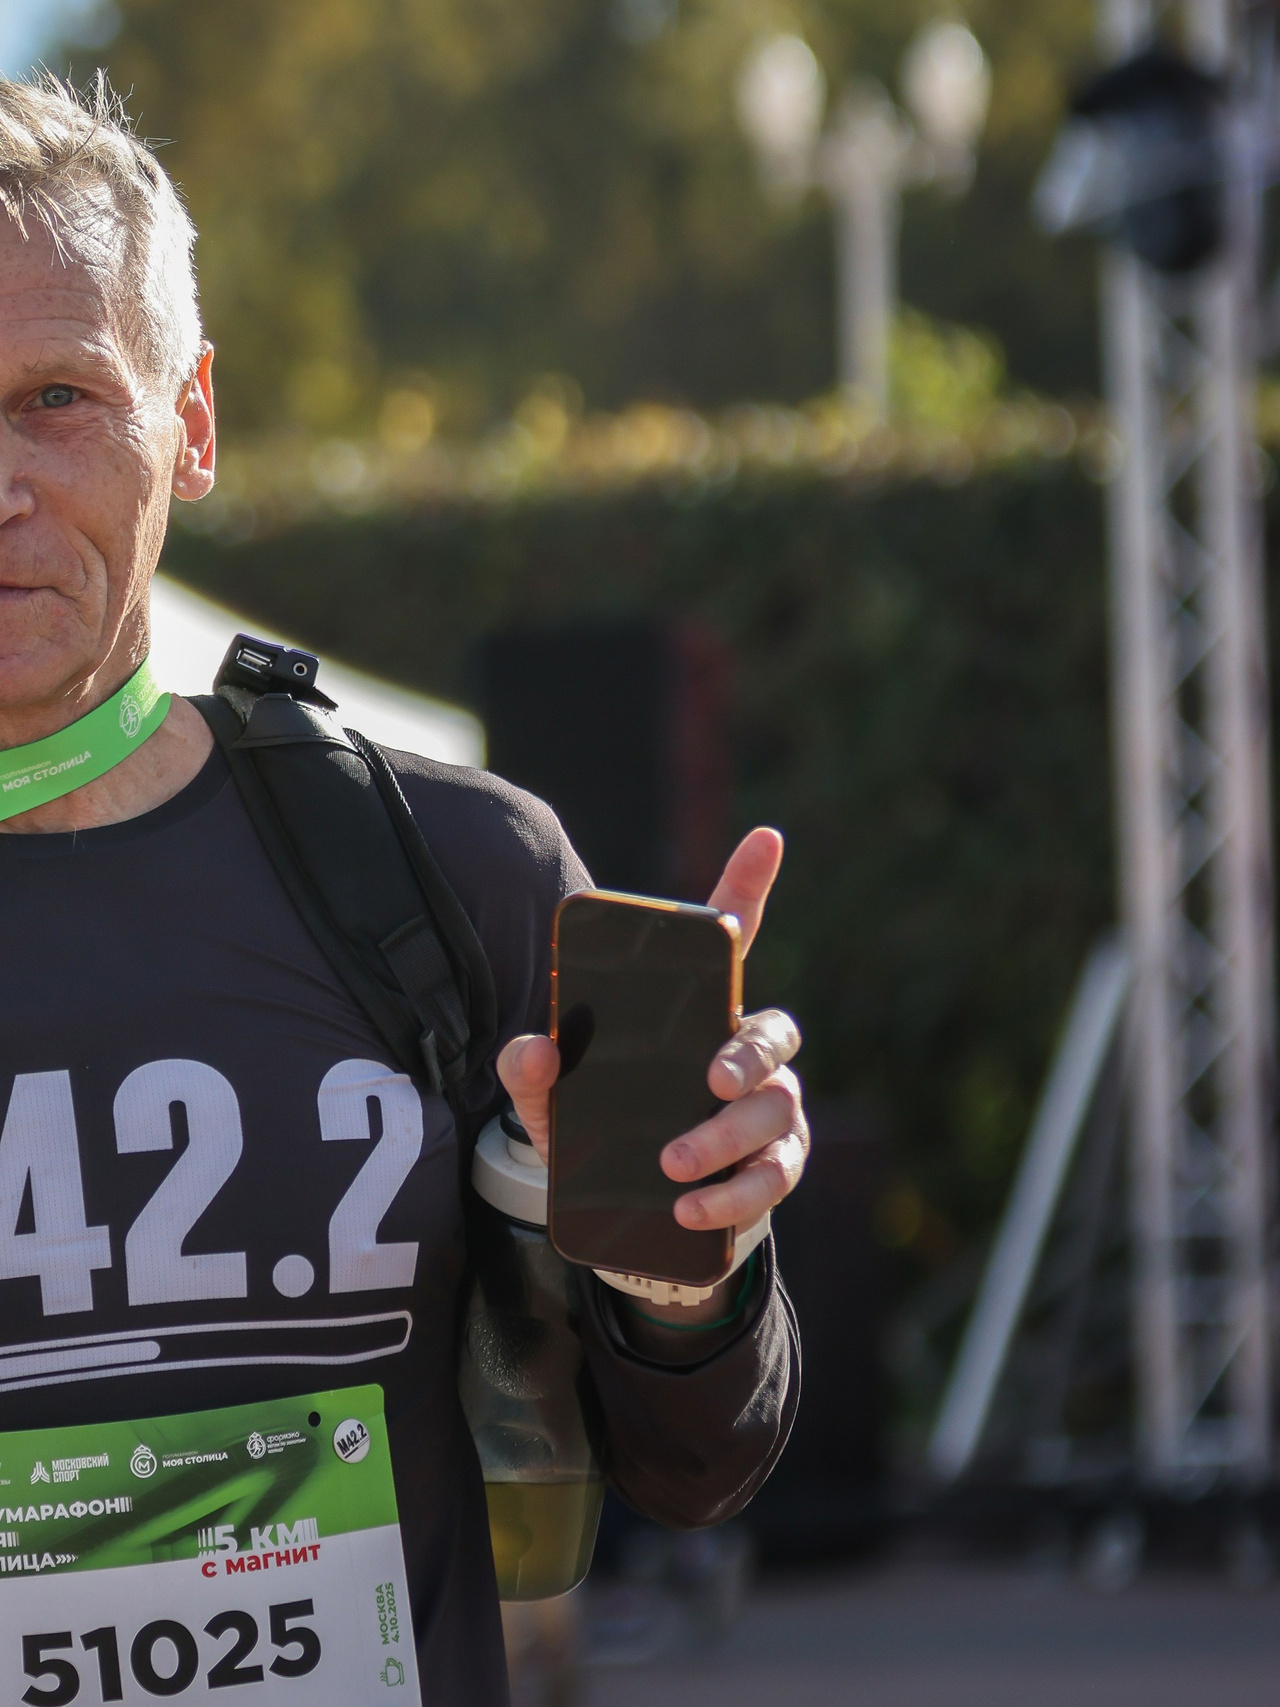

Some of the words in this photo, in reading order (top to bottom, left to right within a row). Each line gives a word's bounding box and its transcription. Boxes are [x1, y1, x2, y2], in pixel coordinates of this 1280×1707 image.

[2, 775, 31, 792] МОЯ
[33, 750, 92, 781] СТОЛИЦА
[336, 1423, 367, 1455] M42.2
[52, 1452, 109, 1471] МОСКОВСКИЙ
[162, 1458, 183, 1468] МОЯ
[185, 1452, 228, 1465] СТОЛИЦА
[53, 1470, 80, 1483] СПОРТ
[214, 1524, 238, 1555] 5
[375, 1583, 390, 1645] МОСКВА
[385, 1582, 399, 1643] 4.10.2025
[21, 1598, 322, 1707] 51025
